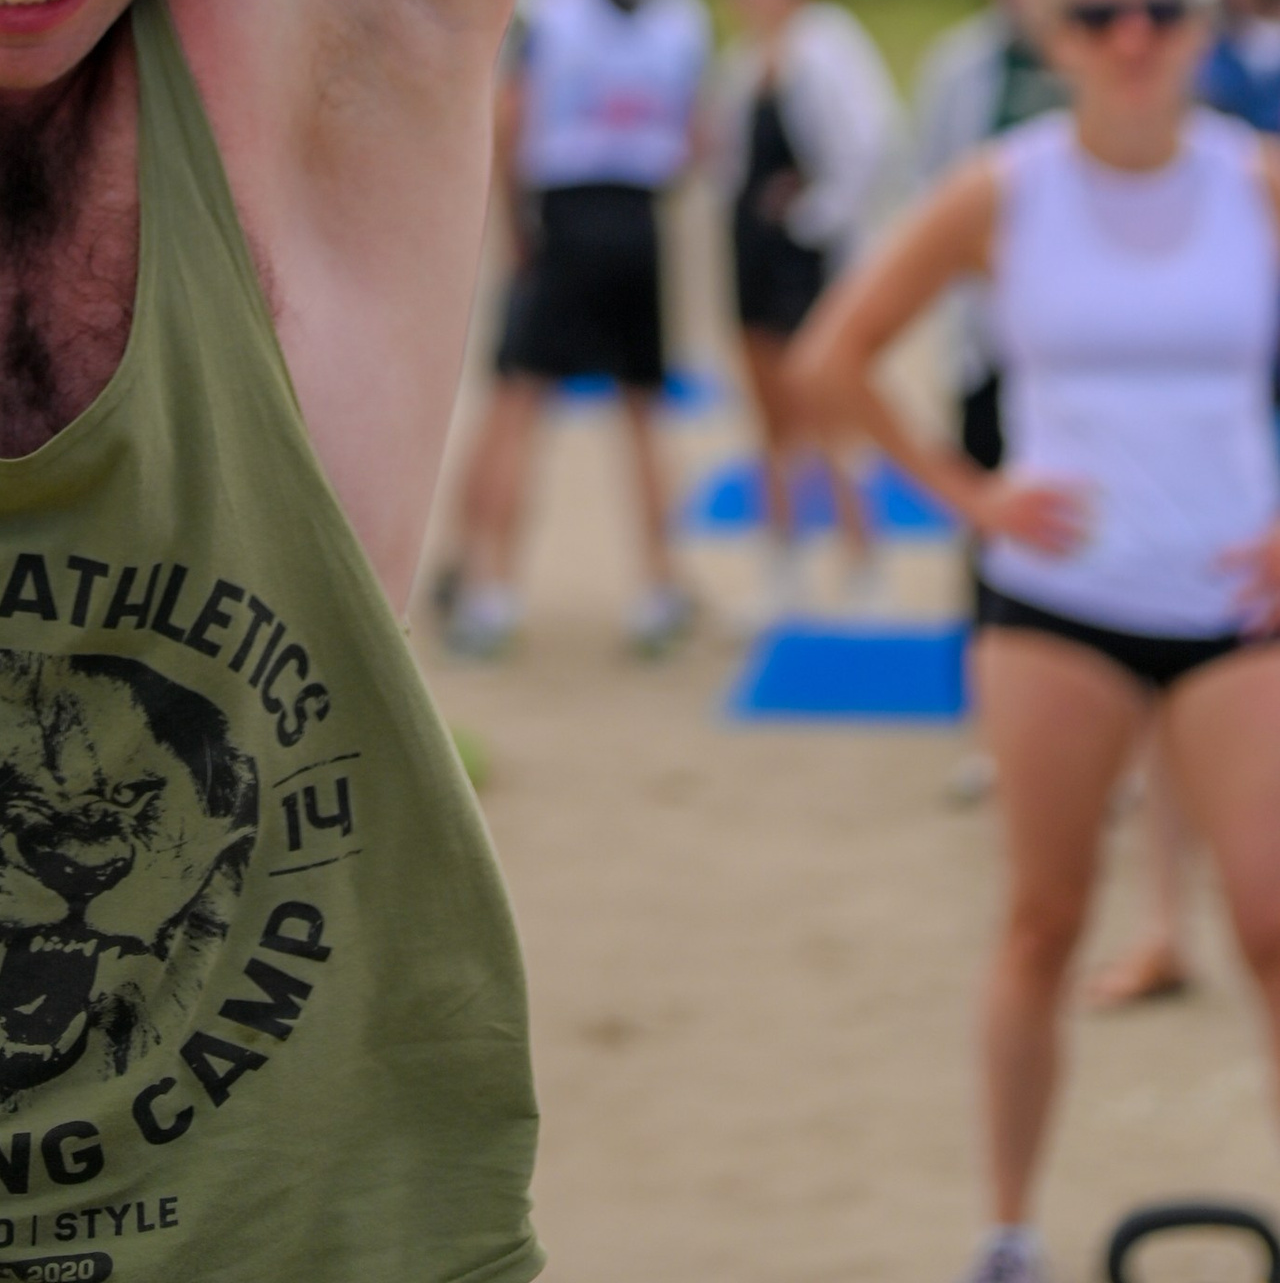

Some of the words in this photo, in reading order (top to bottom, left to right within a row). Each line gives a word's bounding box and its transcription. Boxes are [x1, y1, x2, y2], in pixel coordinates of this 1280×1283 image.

[282, 776, 353, 853] 14
[131, 900, 333, 1146] CAMP
[53, 1195, 180, 1242] STYLE
